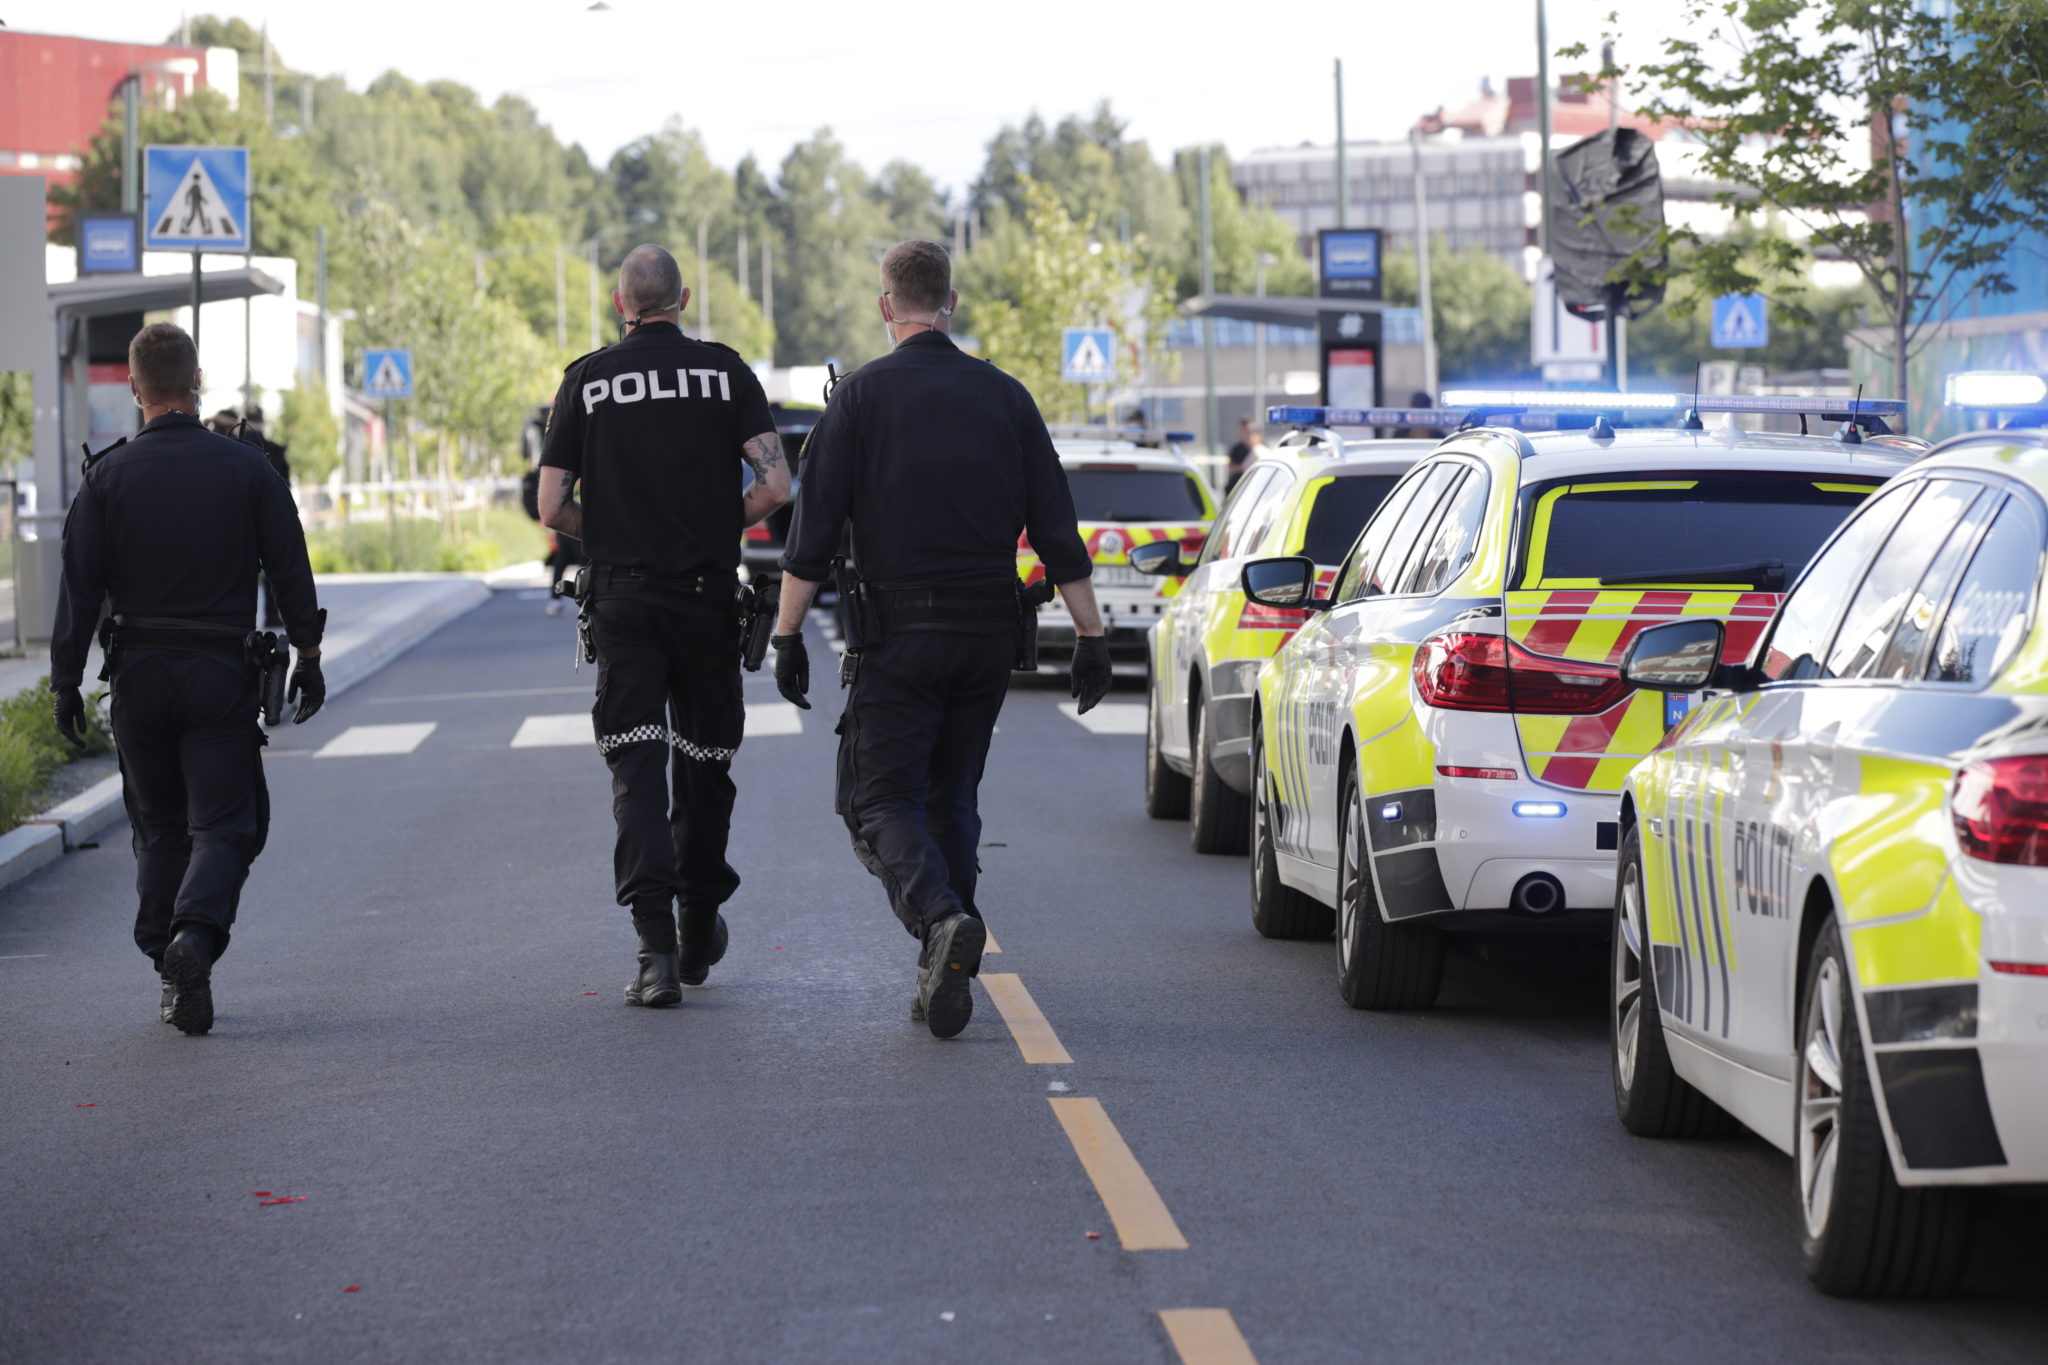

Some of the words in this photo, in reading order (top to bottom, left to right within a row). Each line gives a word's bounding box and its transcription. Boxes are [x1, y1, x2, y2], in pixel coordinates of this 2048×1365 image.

[582, 368, 731, 415] POLITI
[1308, 701, 1338, 766] POLITI
[1672, 709, 1684, 721] N
[1734, 820, 1796, 921] POLITI
